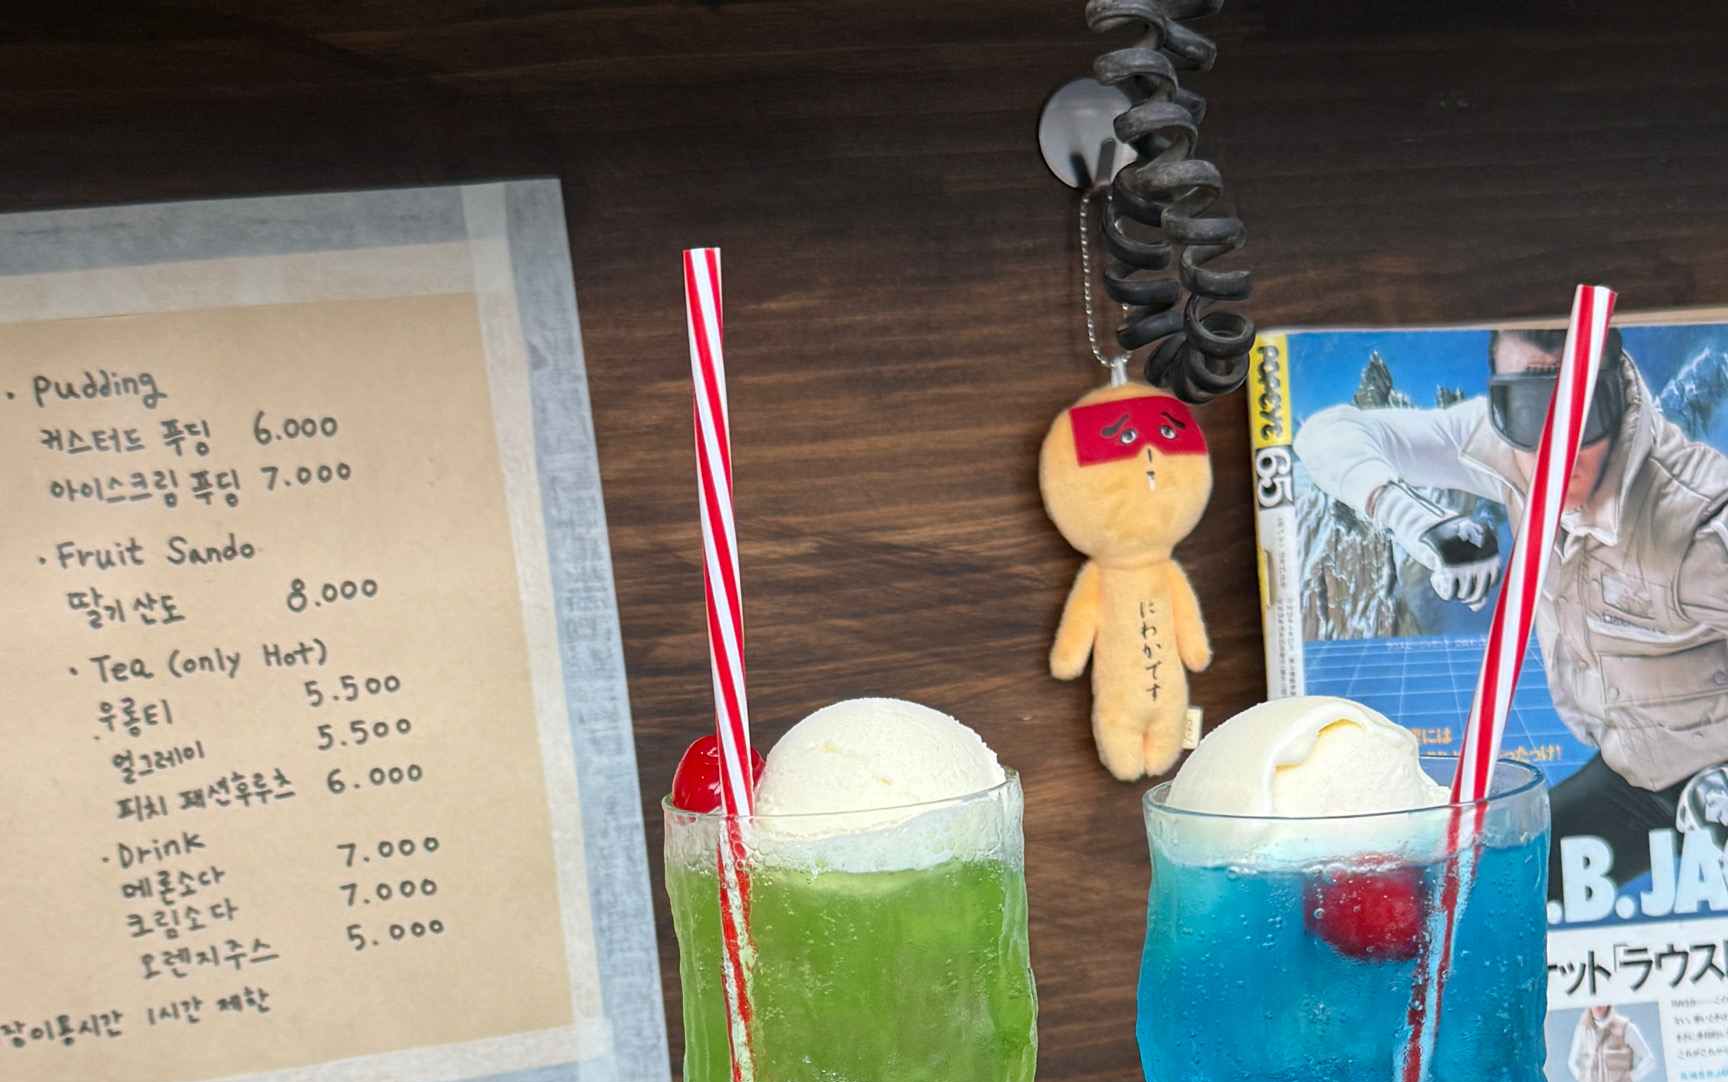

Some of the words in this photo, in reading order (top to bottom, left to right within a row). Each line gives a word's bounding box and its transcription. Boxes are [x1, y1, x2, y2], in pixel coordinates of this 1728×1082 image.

[33, 370, 167, 409] pudding
[40, 428, 145, 454] 커스터드
[160, 419, 210, 456] 푸딩
[253, 411, 337, 445] 6.000
[50, 469, 178, 508] 아이스크림
[190, 469, 240, 508] 푸딩
[260, 462, 351, 490] 7.000
[1255, 447, 1293, 507] 65
[56, 537, 144, 570] Fruit
[166, 533, 255, 565] Sando
[287, 578, 378, 613] 8.000
[89, 654, 154, 683] Tea
[168, 648, 240, 679] (only
[262, 638, 327, 667] Hot)
[1140, 601, 1162, 701] にわかです
[98, 697, 173, 737] 우롱티
[304, 675, 401, 707] 5.500
[112, 740, 205, 785] 얼그레이
[317, 718, 411, 751] 5.500
[116, 795, 168, 822] 피치
[327, 764, 423, 794] 6.000
[117, 832, 206, 869] Drink
[121, 866, 225, 906] 메론소다
[336, 837, 439, 867] 7.000
[127, 898, 238, 940] 크림소다
[339, 878, 437, 906] 7.000
[140, 938, 280, 980] 오렌지주스
[346, 920, 444, 951] 5.000
